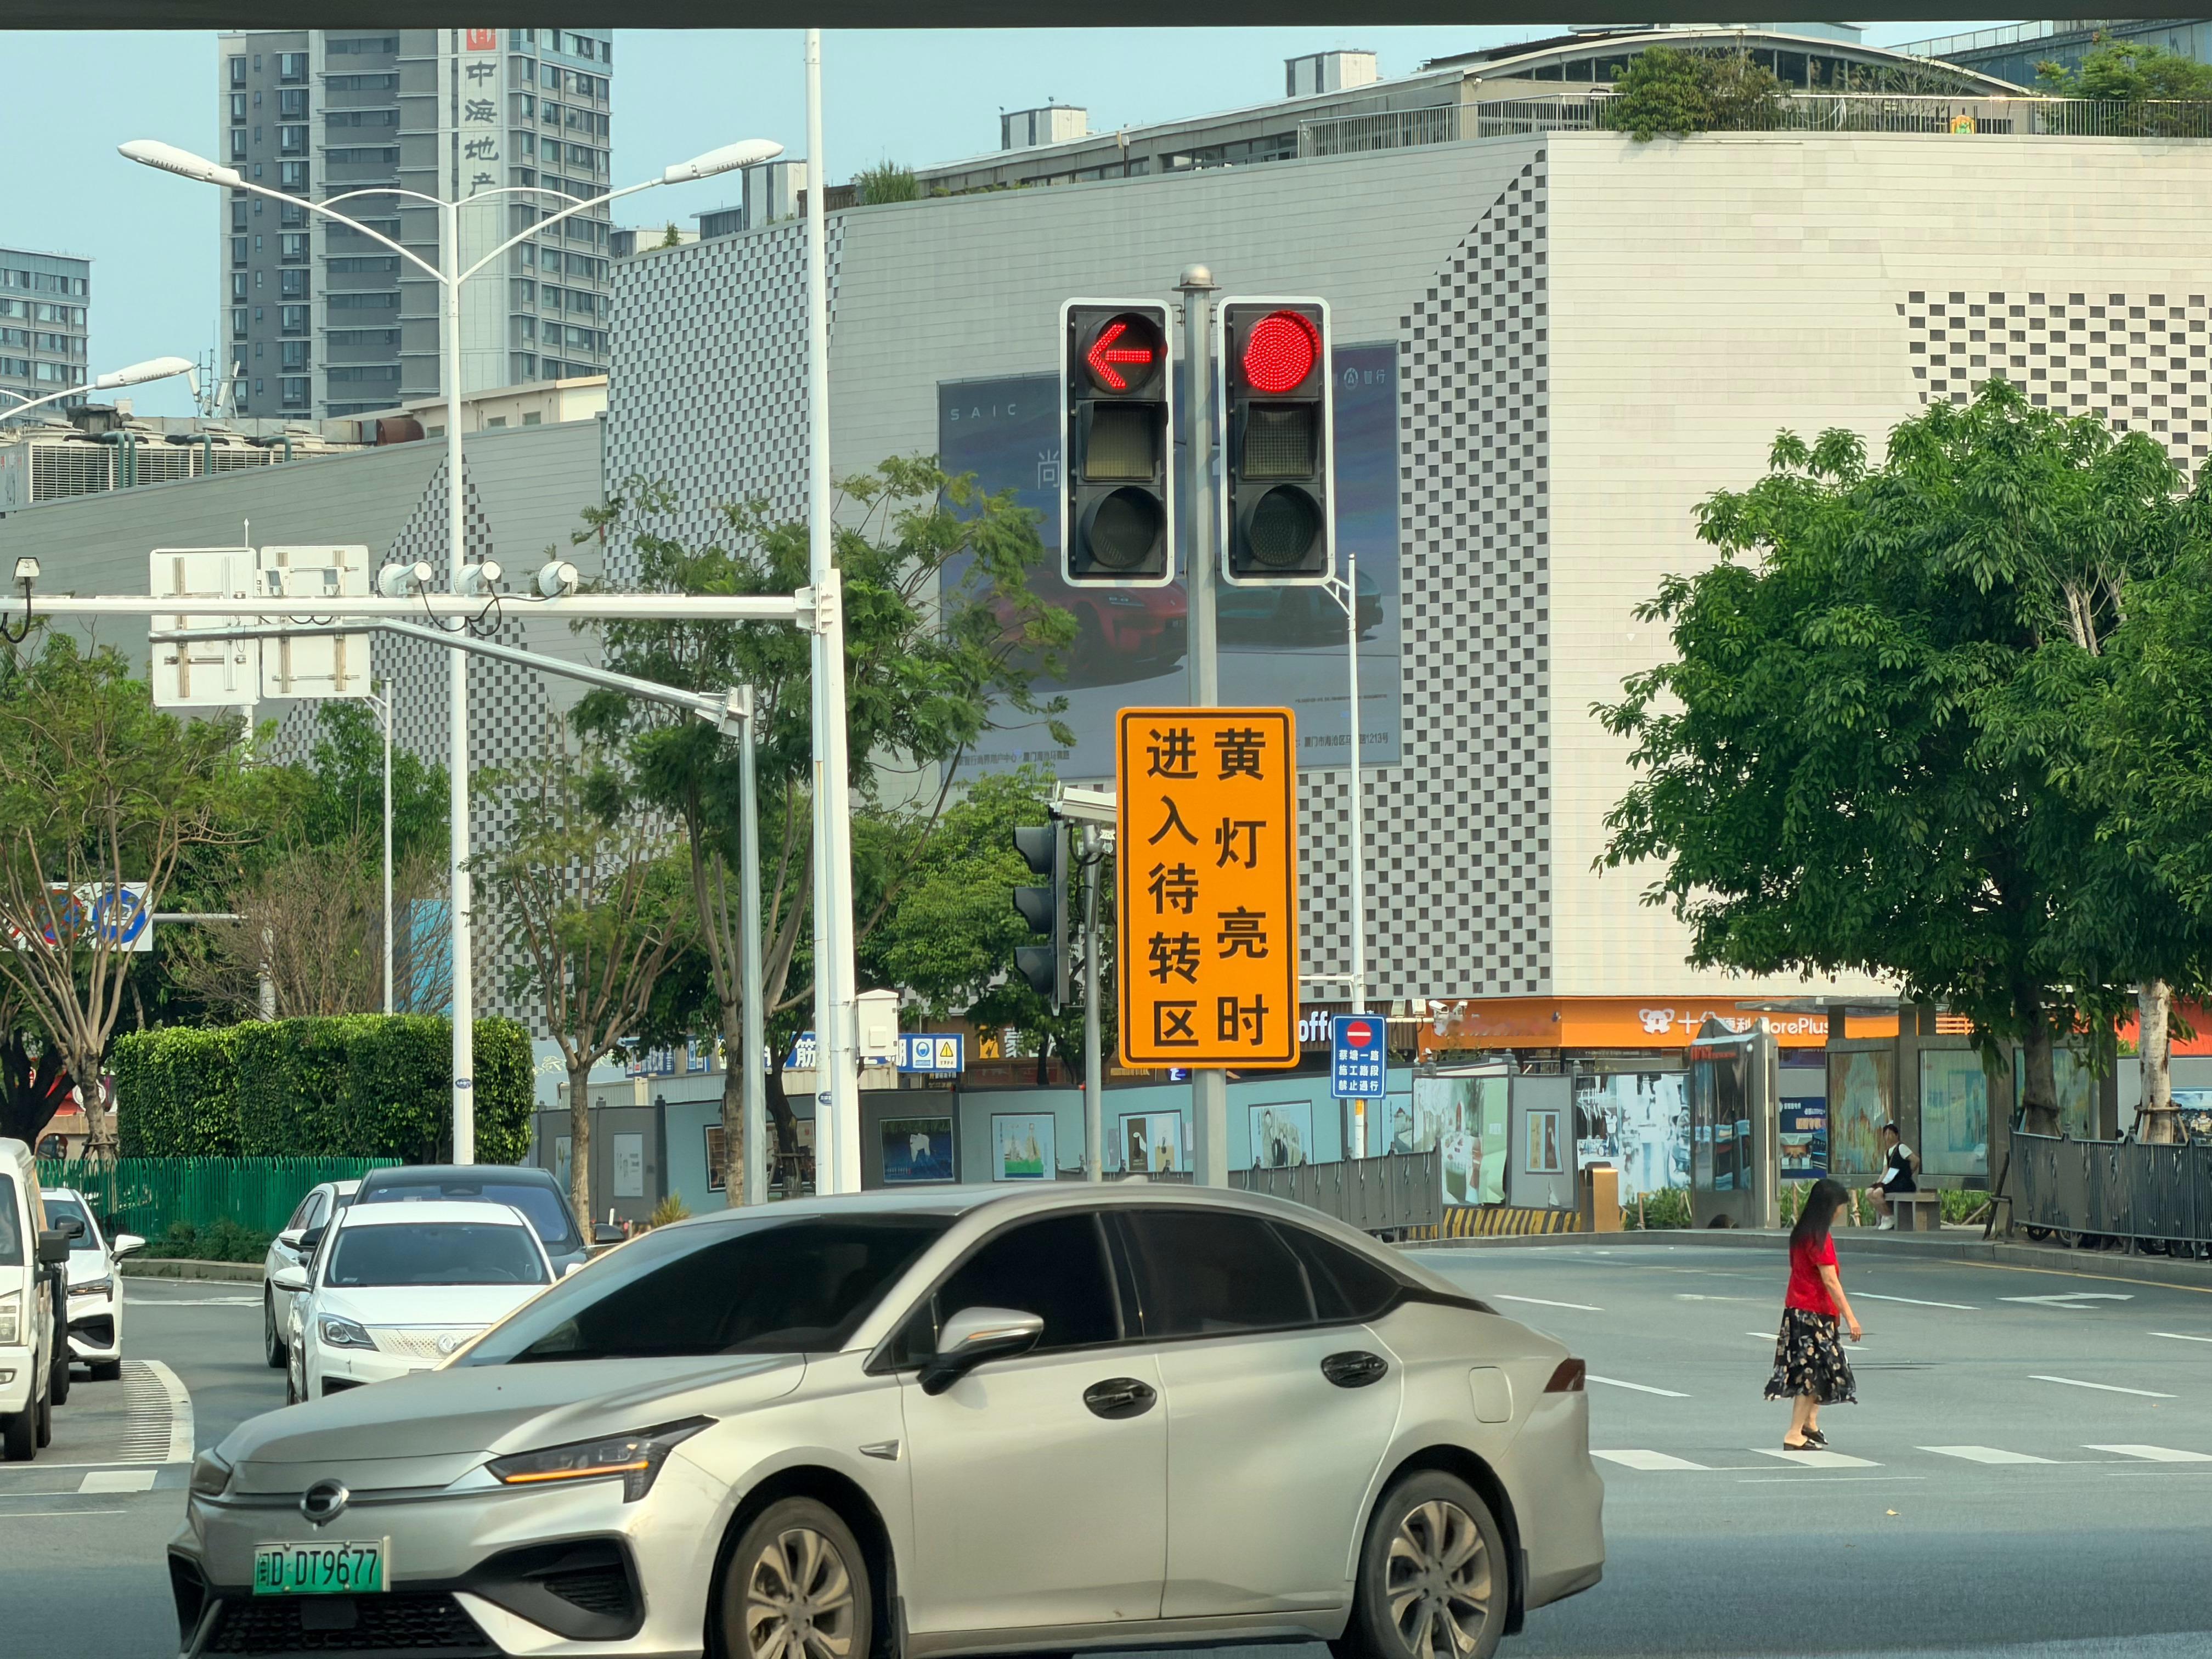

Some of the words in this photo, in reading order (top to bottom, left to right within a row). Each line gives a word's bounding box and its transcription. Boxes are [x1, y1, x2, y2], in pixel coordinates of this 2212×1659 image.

[465, 60, 499, 197] 中海地产
[950, 404, 1017, 421] SAIC
[1146, 727, 1201, 1047] 进入待转区
[1214, 727, 1269, 1046] 黄灯亮时
[1299, 1011, 1332, 1042] off
[1339, 1064, 1379, 1076] 施工路段
[1338, 1080, 1379, 1092] 禁止通行
